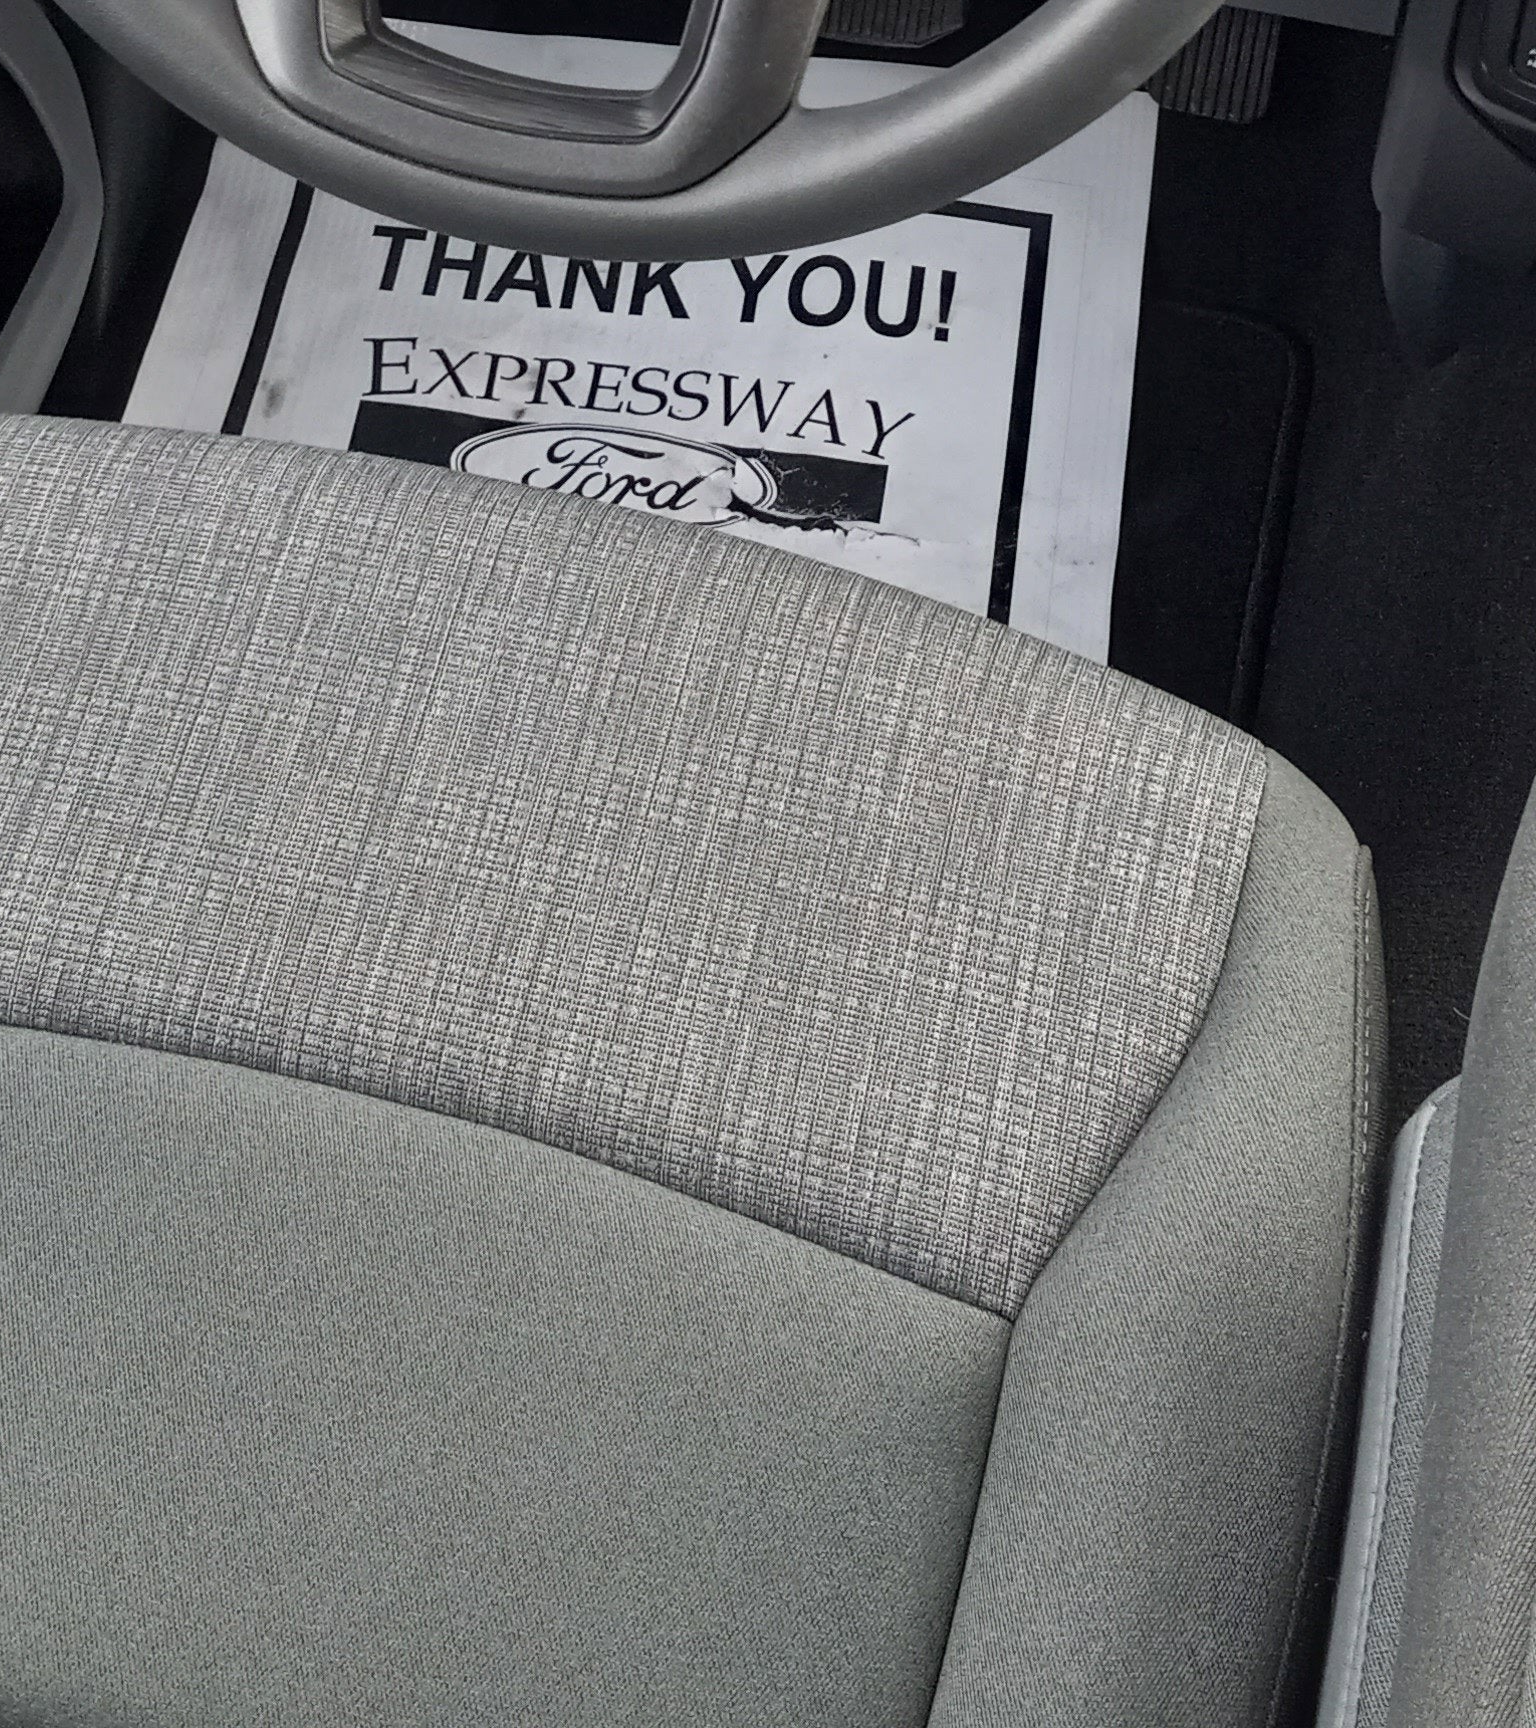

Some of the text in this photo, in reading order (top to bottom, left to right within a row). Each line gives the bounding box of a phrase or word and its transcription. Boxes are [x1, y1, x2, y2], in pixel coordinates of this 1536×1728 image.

[371, 224, 958, 343] THANK YOU!
[362, 336, 916, 460] EXPRESSWAY
